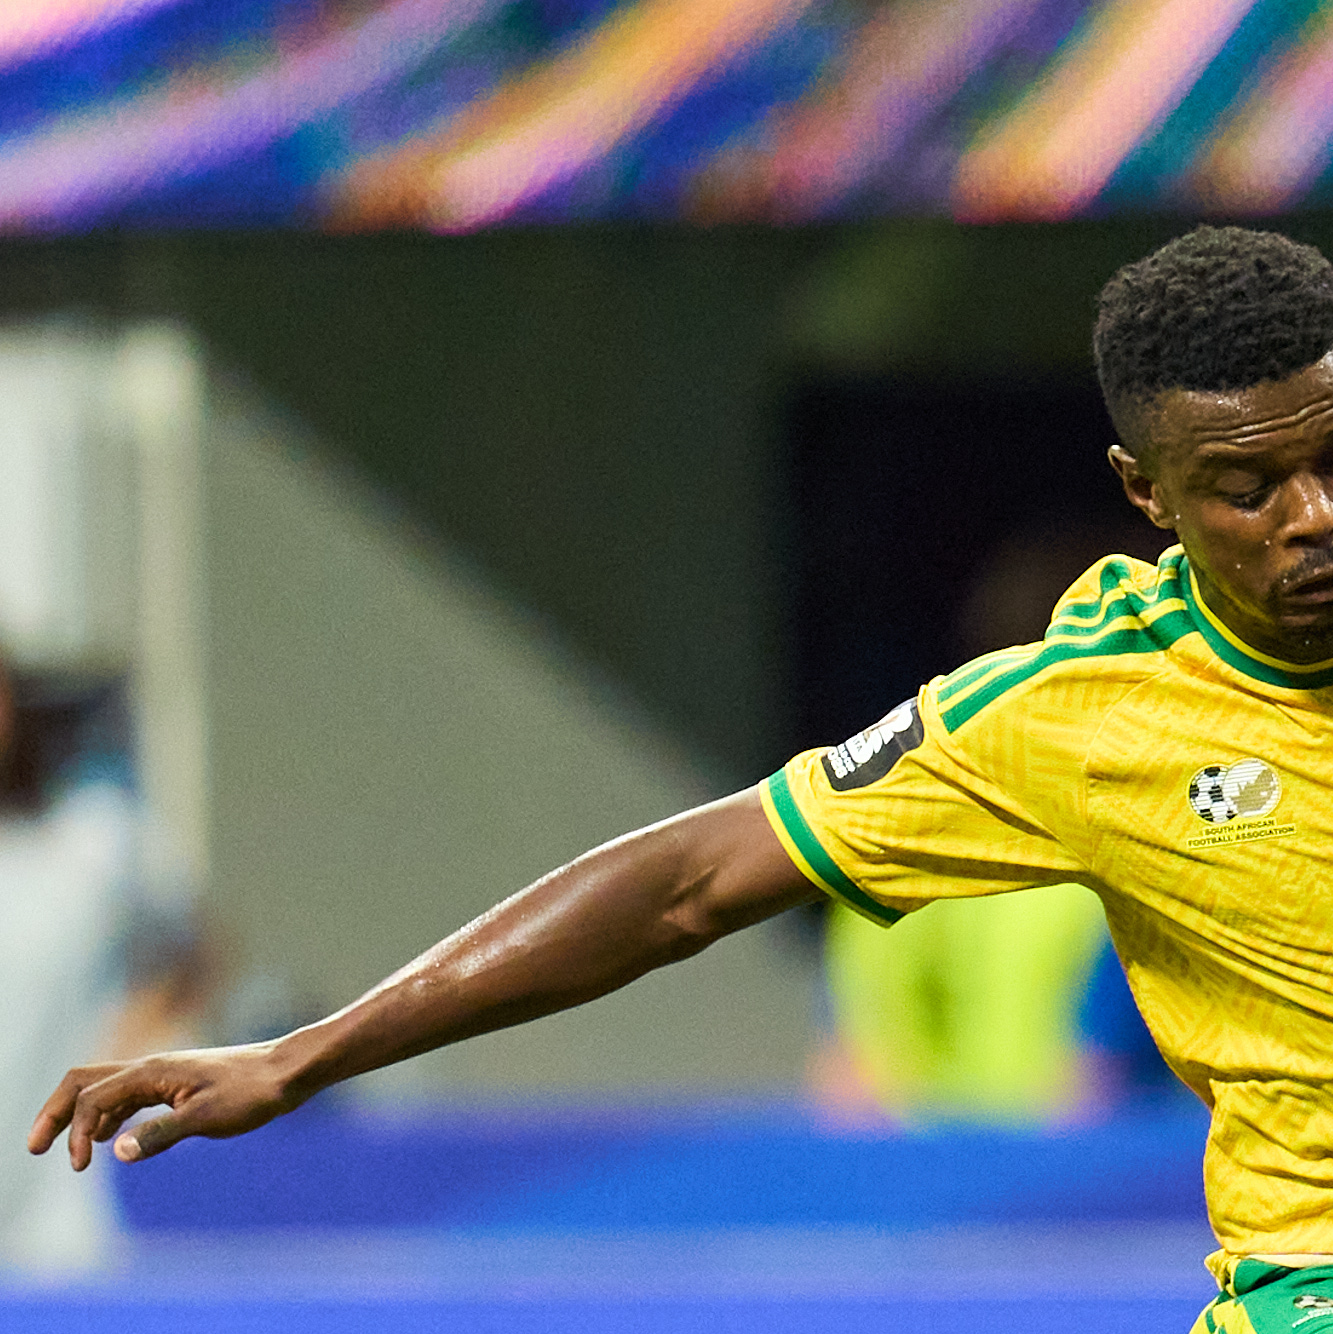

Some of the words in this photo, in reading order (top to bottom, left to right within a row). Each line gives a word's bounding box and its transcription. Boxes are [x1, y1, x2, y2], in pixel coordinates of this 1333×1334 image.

[1188, 834, 1233, 847] FOOTBALL
[1235, 825, 1295, 841] ASSOCIATION
[1204, 825, 1235, 836] SOUTH
[1236, 819, 1275, 832] AFRICAN
